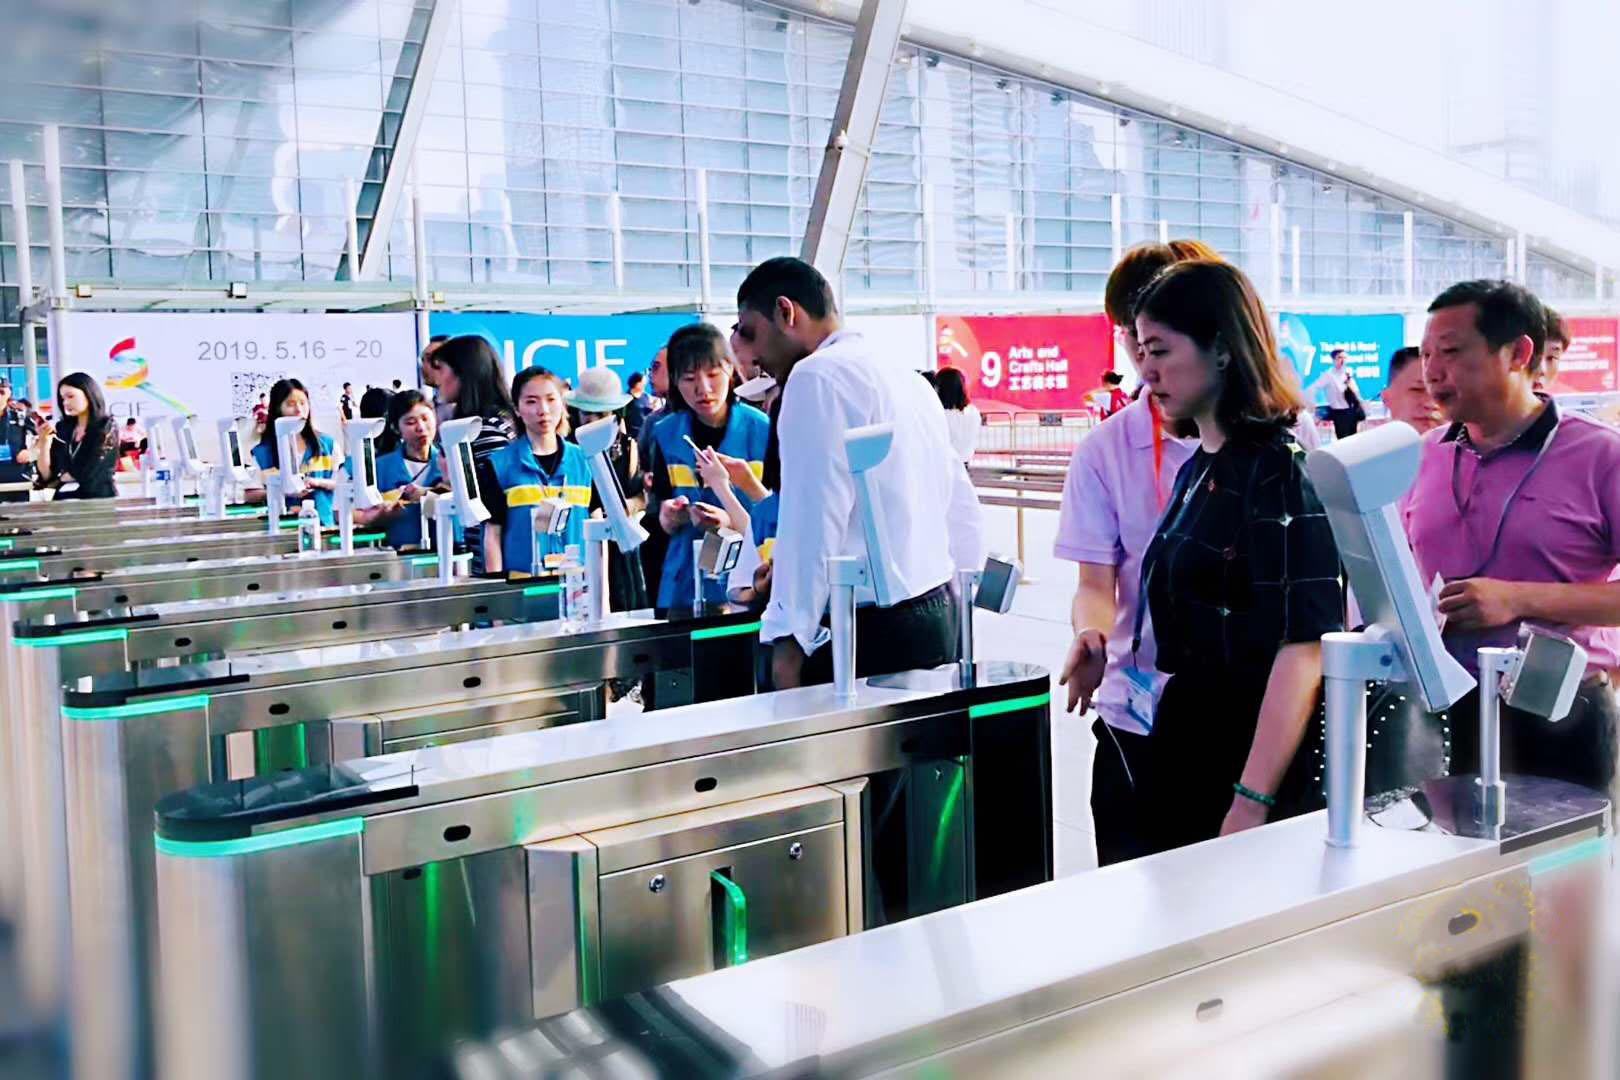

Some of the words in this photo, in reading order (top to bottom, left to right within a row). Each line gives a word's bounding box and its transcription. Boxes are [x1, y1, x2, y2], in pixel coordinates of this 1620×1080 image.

[197, 341, 266, 361] 2019.
[275, 340, 327, 360] 5.16
[355, 339, 383, 358] 20
[1302, 345, 1316, 376] 7
[981, 351, 1001, 388] 9
[109, 401, 153, 417] CIF
